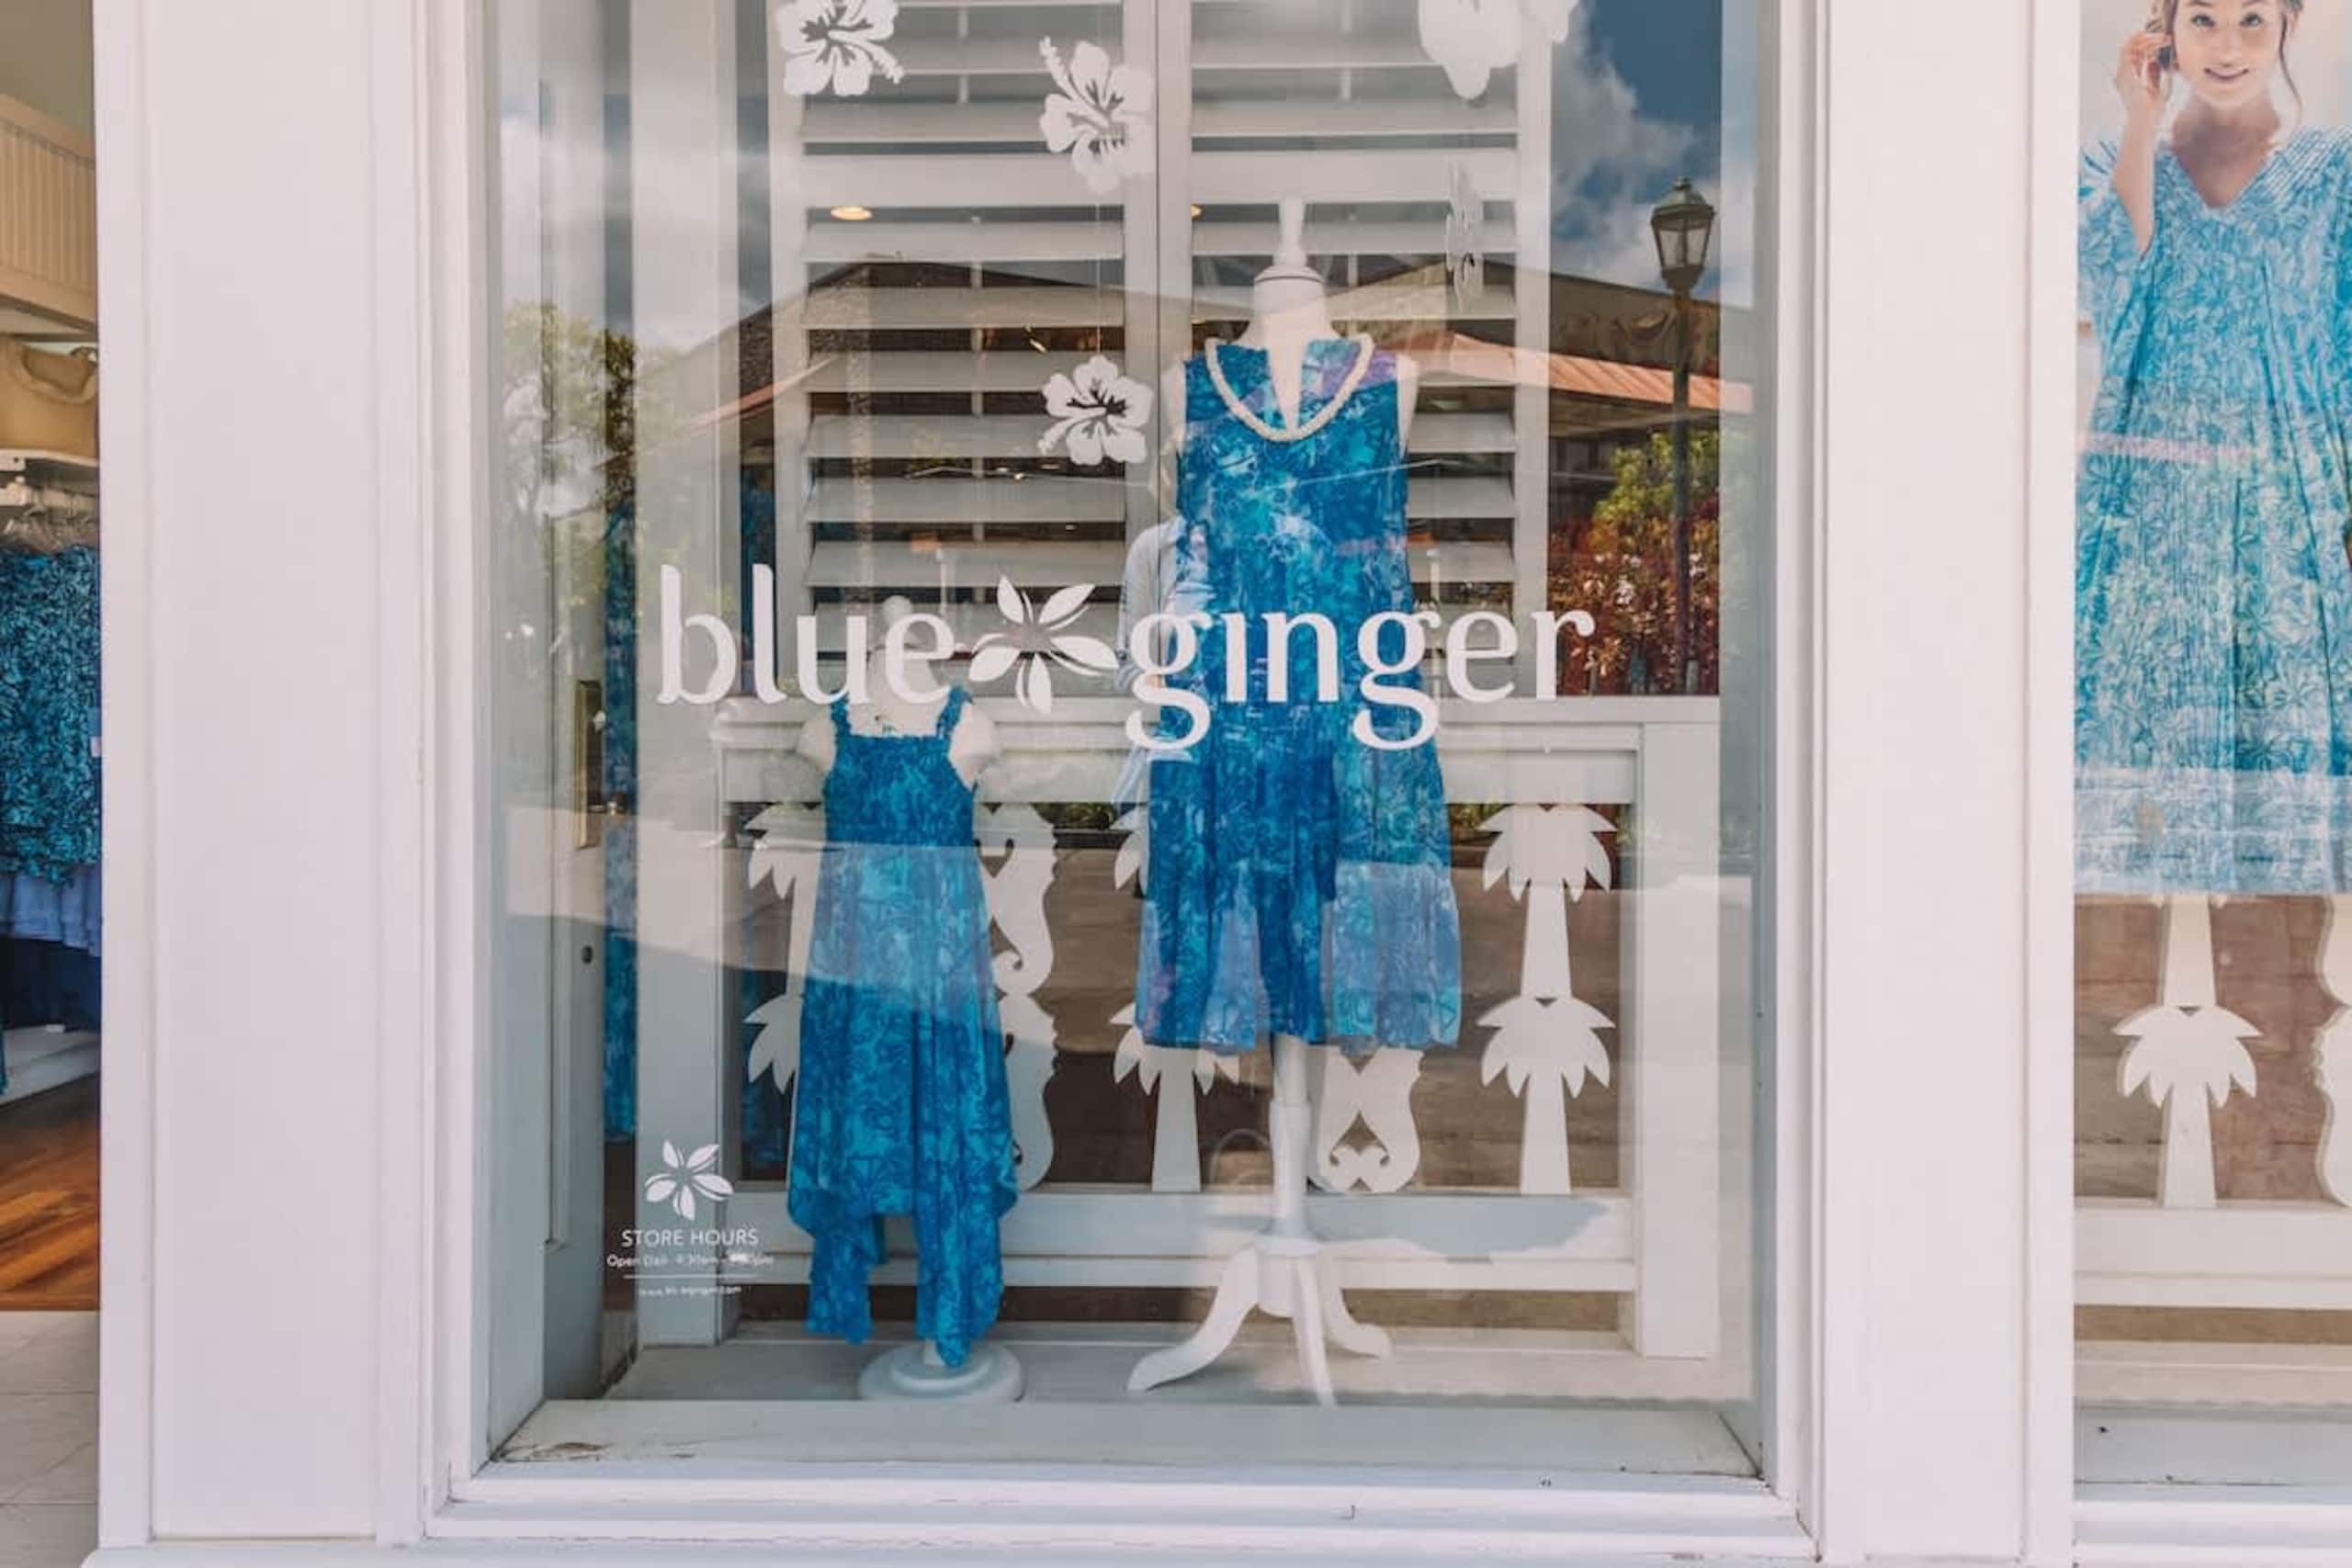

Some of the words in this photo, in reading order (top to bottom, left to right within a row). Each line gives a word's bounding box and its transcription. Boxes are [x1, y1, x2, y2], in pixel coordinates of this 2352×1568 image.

[656, 564, 956, 706] blue
[1125, 610, 1595, 751] ginger
[621, 1229, 684, 1247] STORE
[691, 1228, 759, 1246] HOURS
[606, 1254, 640, 1268] Open
